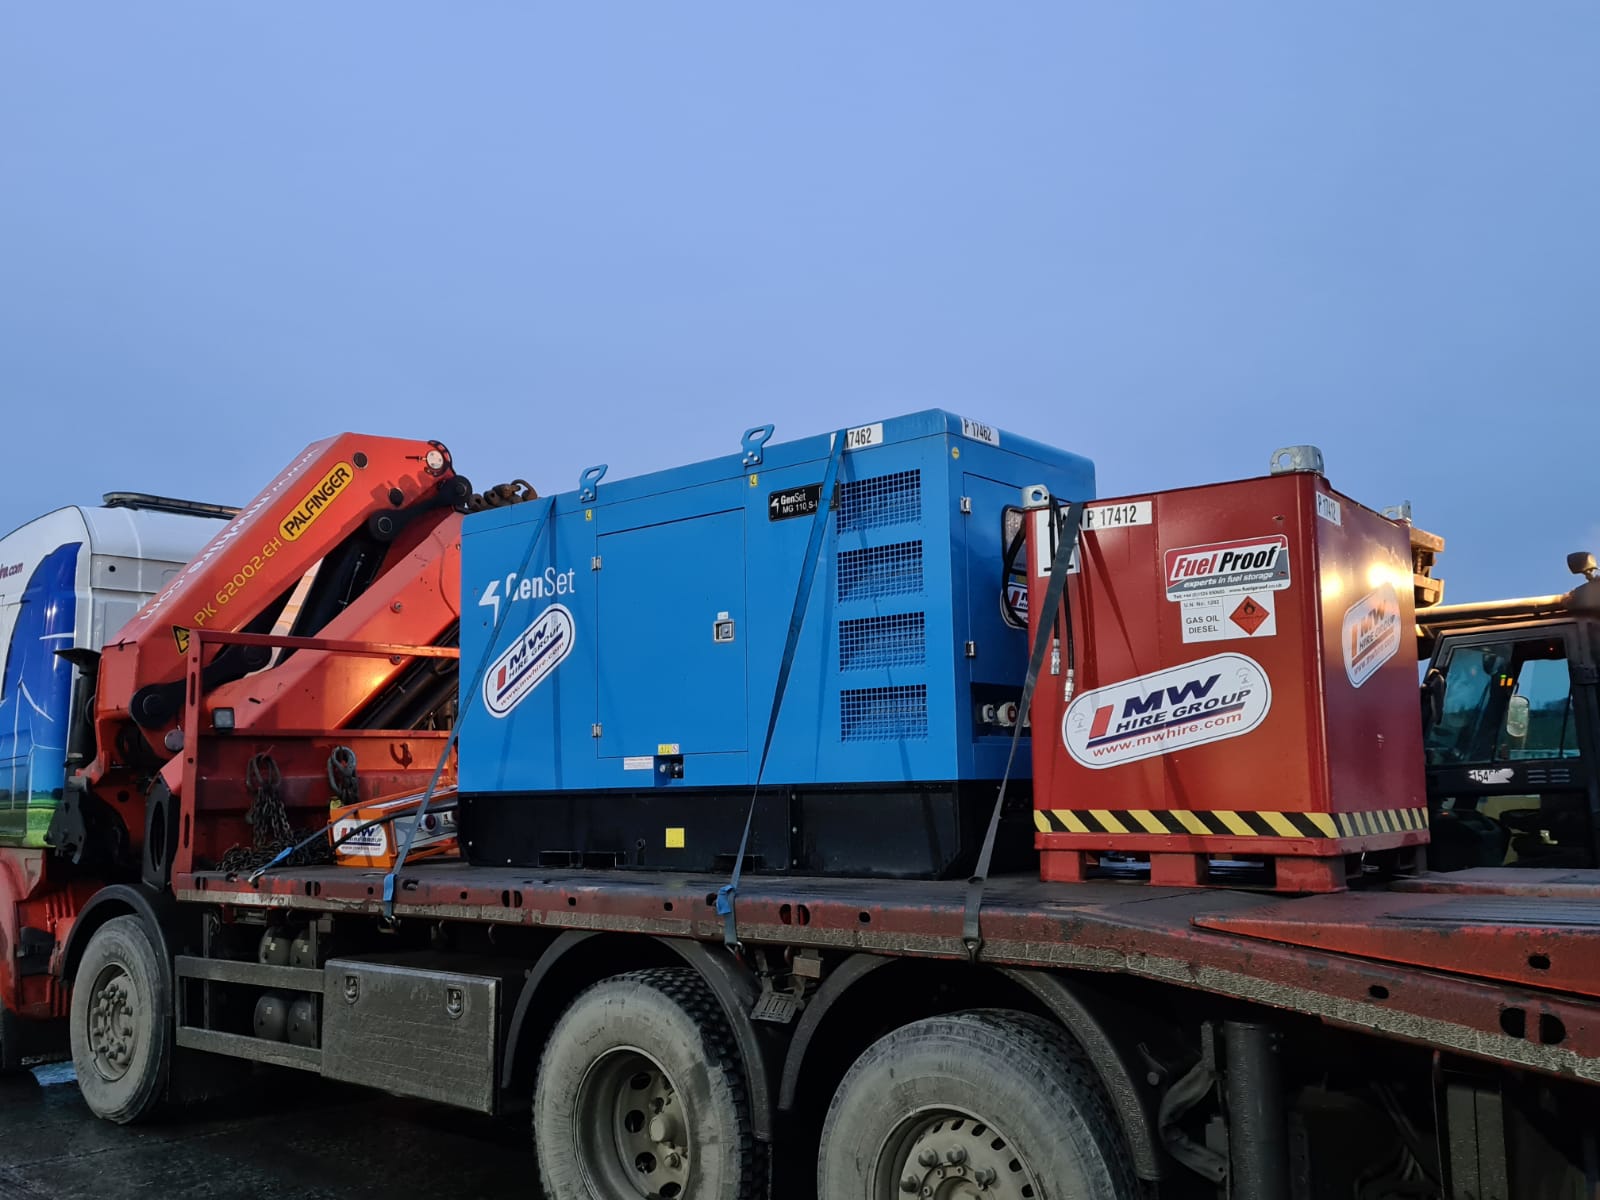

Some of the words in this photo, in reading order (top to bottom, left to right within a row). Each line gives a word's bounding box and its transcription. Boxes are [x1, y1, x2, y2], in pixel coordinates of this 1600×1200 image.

[971, 422, 992, 441] 17462
[283, 467, 350, 537] PALFINGER
[780, 489, 806, 505] GenSet
[782, 504, 794, 513] MG
[795, 502, 807, 511] 110
[1100, 505, 1137, 526] 17412
[1174, 554, 1219, 578] Fuel
[1219, 546, 1278, 573] Proof
[194, 602, 217, 626] PK
[215, 536, 282, 605] 62002-EH
[1183, 579, 1217, 589] experts
[1218, 576, 1226, 585] in
[1226, 573, 1243, 583] fuel
[1242, 571, 1274, 582] storage
[1186, 616, 1204, 624] GAS
[1205, 614, 1220, 623] OIL
[1188, 625, 1219, 634] DIESEL
[508, 655, 530, 680] HIRE
[531, 622, 562, 657] GROUP
[510, 622, 548, 670] MW
[1116, 711, 1169, 733] HIRE
[1172, 689, 1252, 719] GROUP
[1122, 673, 1222, 719] MW
[1093, 712, 1243, 757] www.mwhire.com
